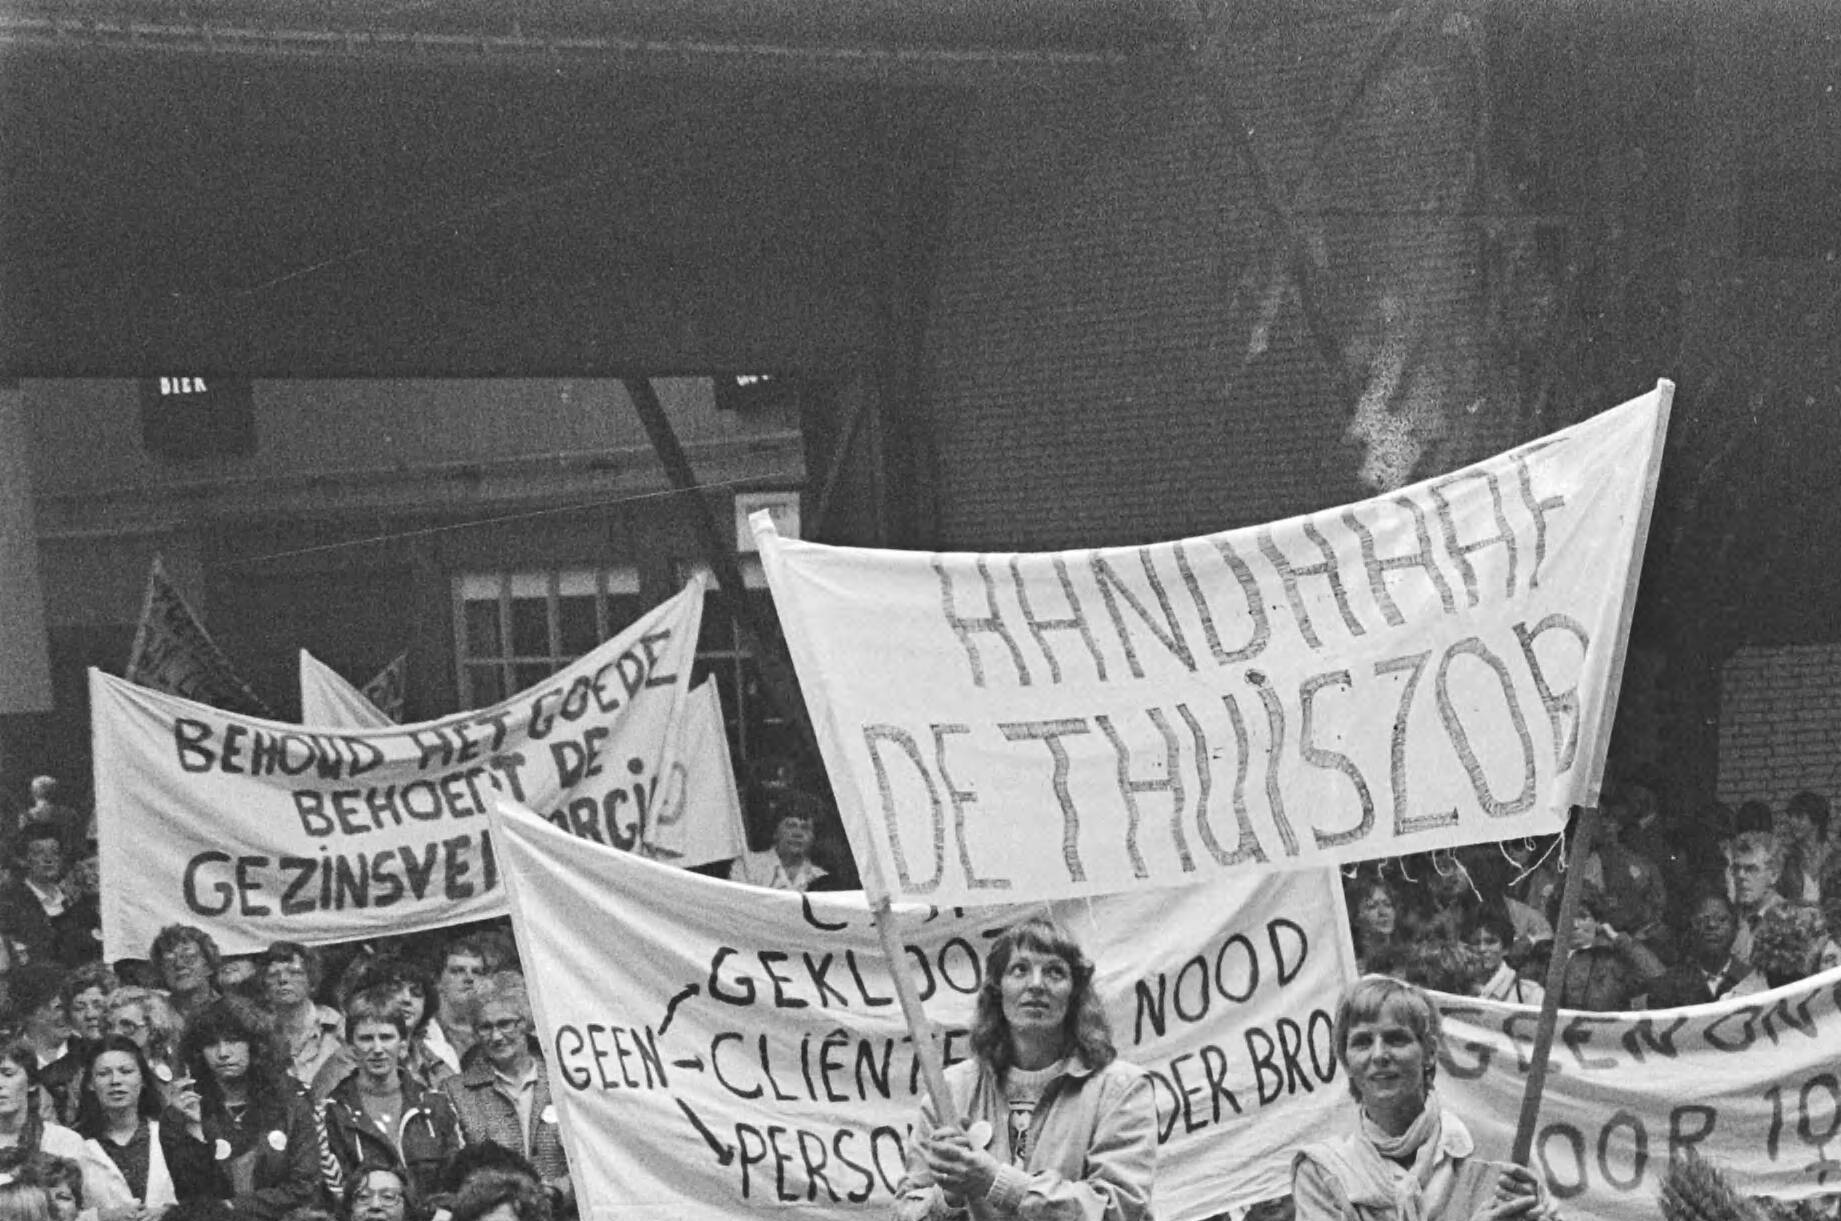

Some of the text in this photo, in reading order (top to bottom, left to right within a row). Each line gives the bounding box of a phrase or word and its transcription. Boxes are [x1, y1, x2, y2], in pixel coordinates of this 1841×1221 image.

[174, 629, 679, 779] BEHOUD HET GOEDE
[550, 726, 610, 789] DE
[997, 612, 1590, 881] THUISZOR
[1132, 916, 1310, 1047] NOOD
[556, 1023, 669, 1095] GEEN
[1154, 1058, 1248, 1143] DER
[1252, 1006, 1338, 1104] BRO
[1436, 1007, 1690, 1080] GEEN
[737, 1120, 914, 1202] PERSO
[1536, 1104, 1716, 1200] OOR
